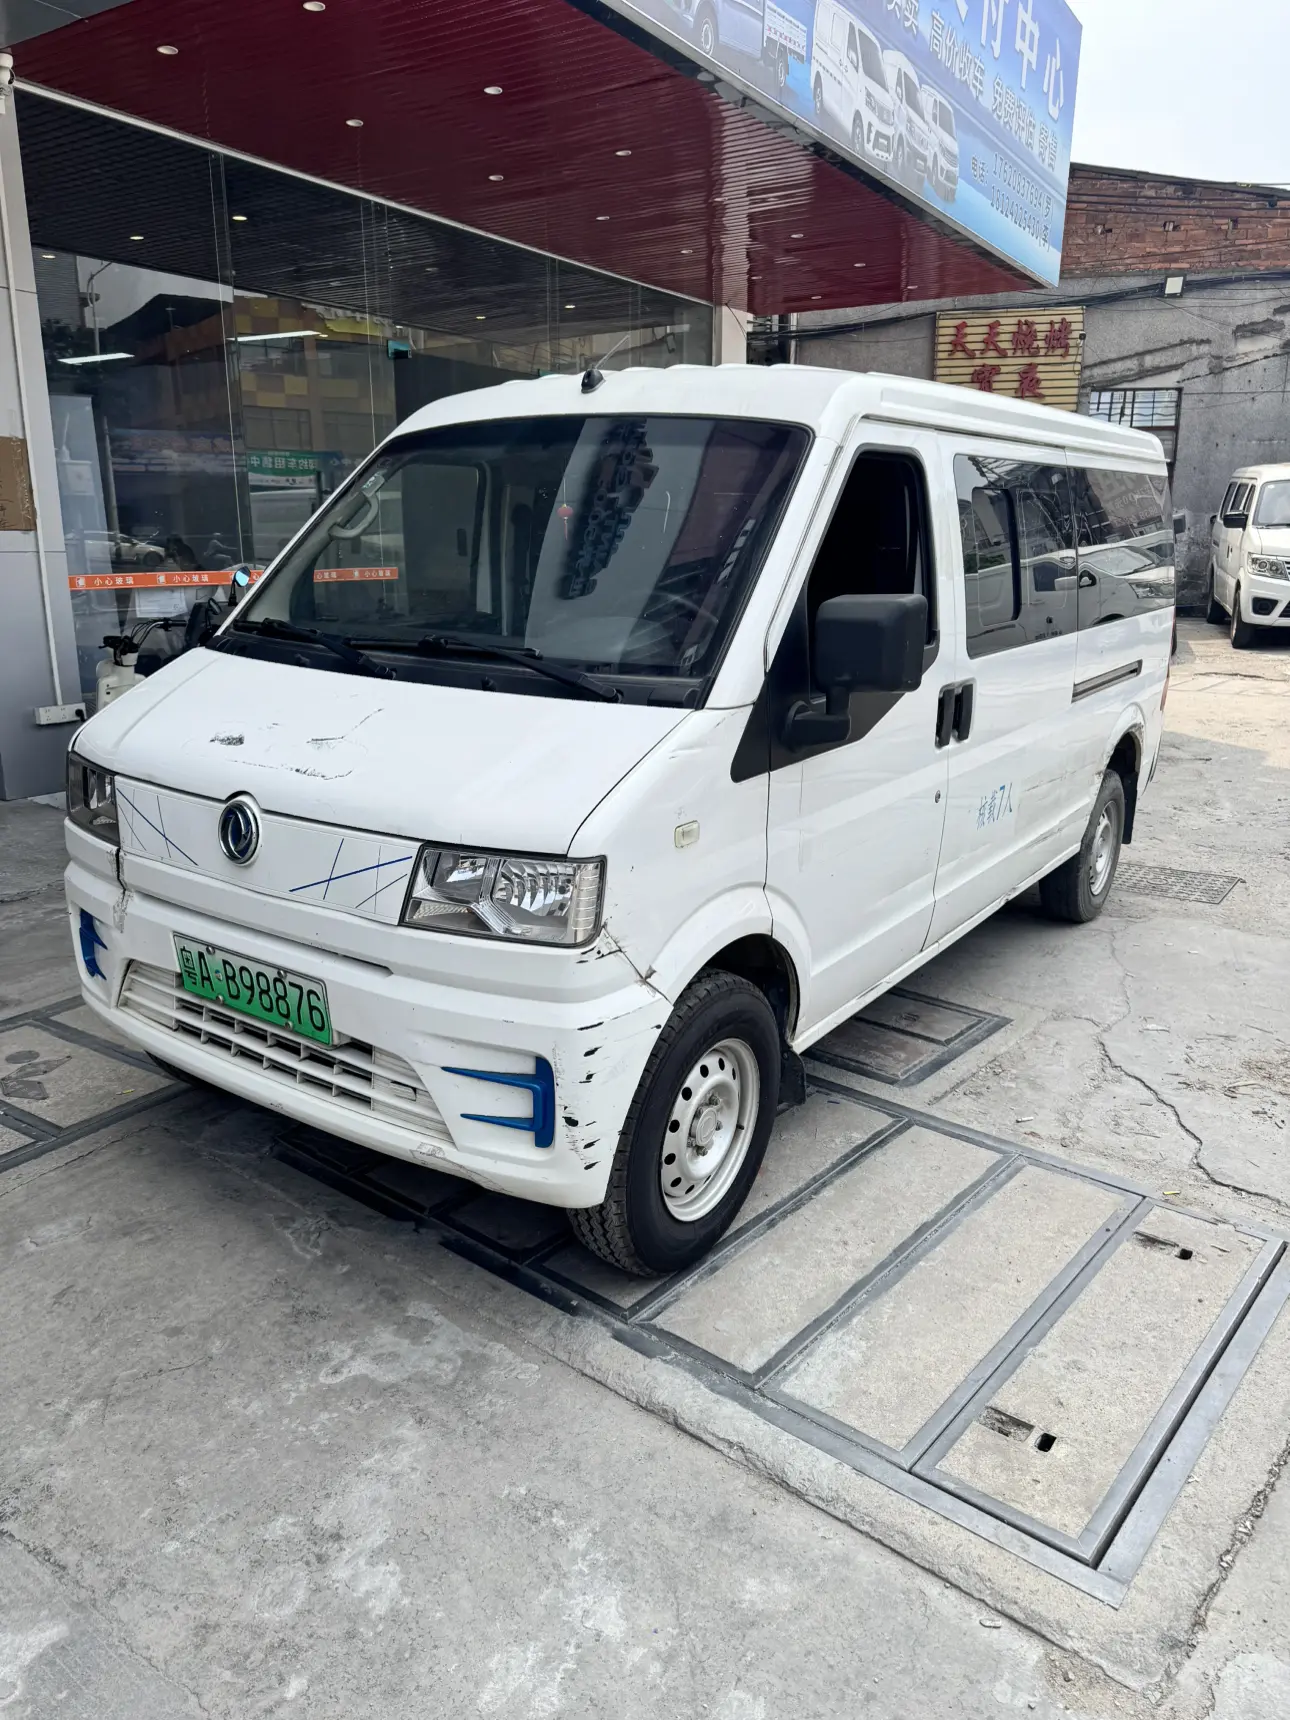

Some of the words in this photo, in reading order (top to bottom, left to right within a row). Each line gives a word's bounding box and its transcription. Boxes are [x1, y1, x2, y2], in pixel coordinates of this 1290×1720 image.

[955, 0, 1064, 121] 付中心
[929, 10, 986, 101] 高价收车
[991, 74, 1036, 151] 免费评估
[172, 573, 209, 583] 小心玻璃
[364, 569, 391, 578] 小心玻璃
[93, 576, 134, 586] 小心玻璃
